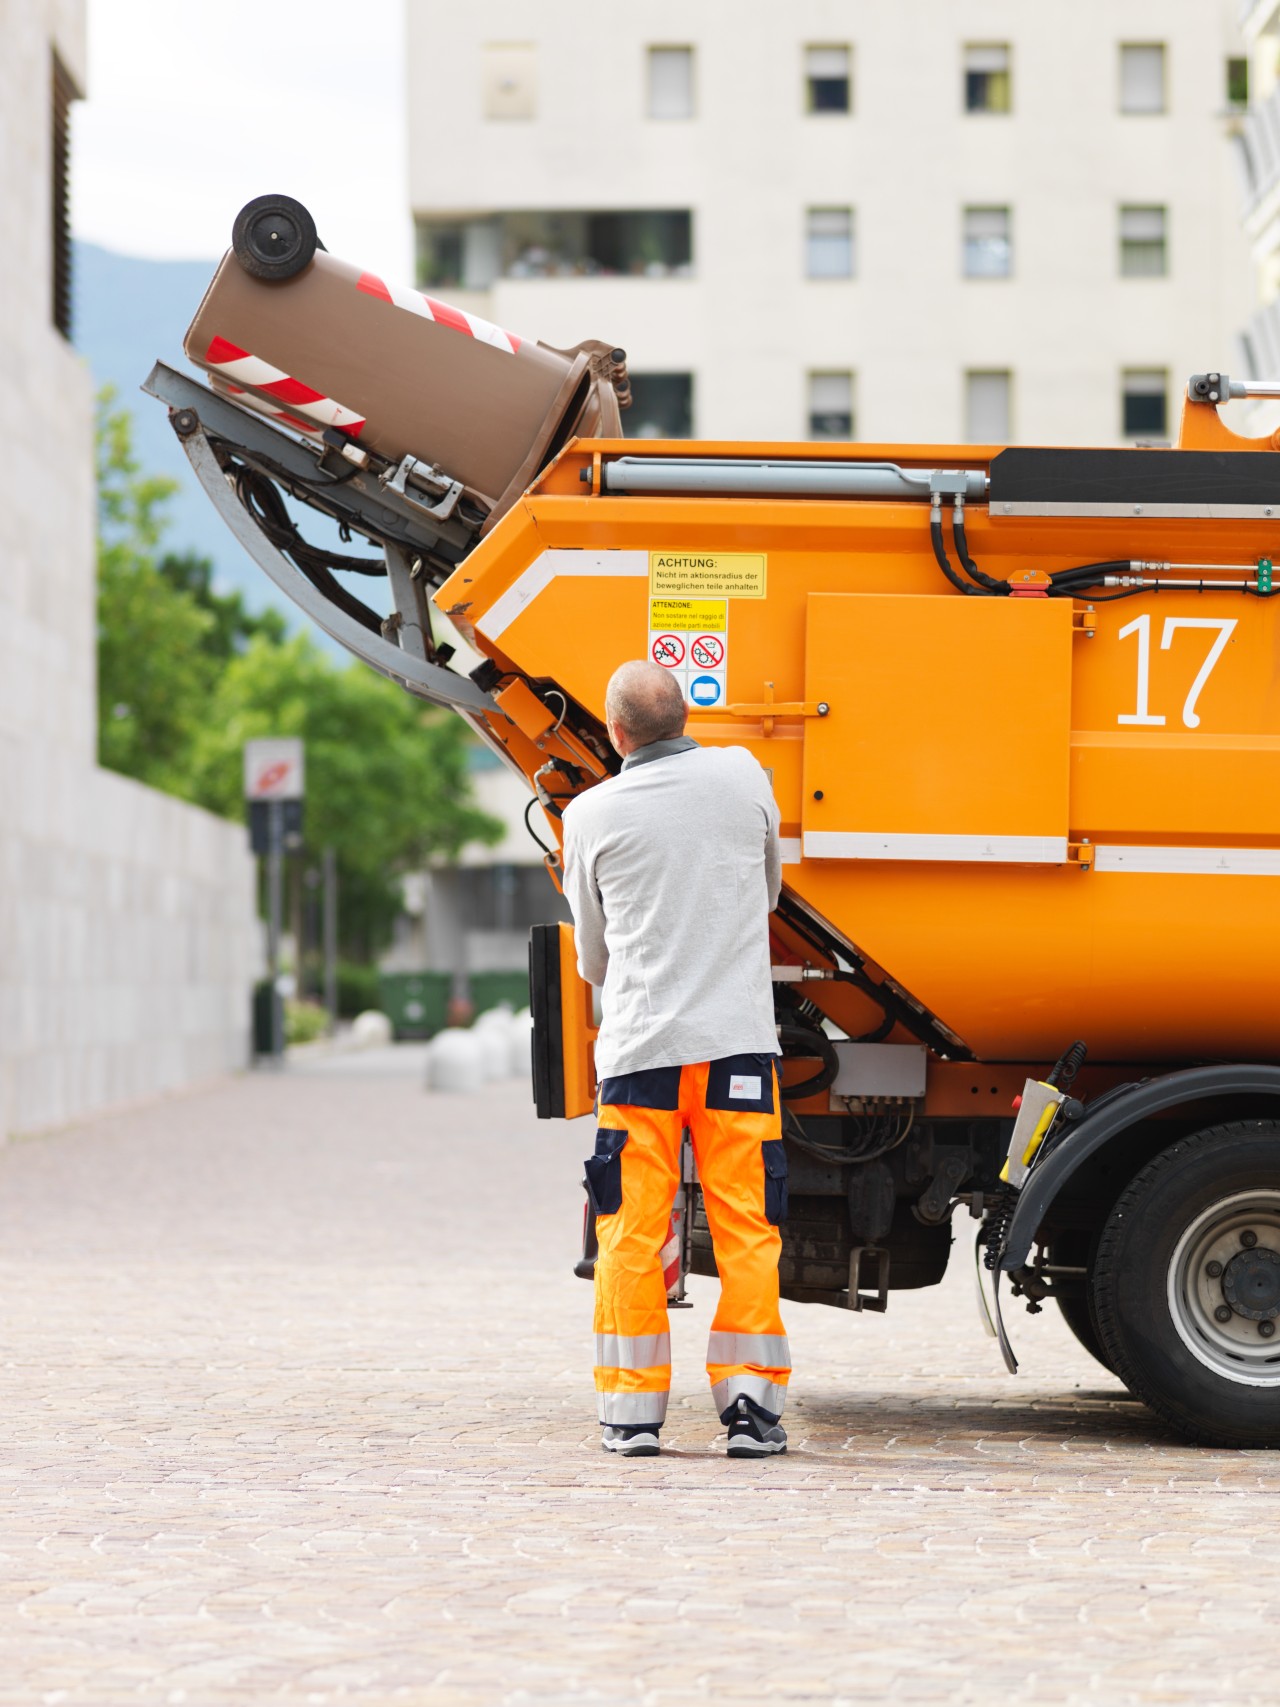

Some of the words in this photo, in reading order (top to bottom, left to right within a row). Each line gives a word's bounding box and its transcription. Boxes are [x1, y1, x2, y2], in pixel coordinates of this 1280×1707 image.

[657, 558, 717, 568] ACHTUNG:
[656, 571, 676, 579] Nicht
[690, 572, 743, 580] aktionsradius
[656, 582, 704, 591] beweglichen
[725, 583, 758, 591] anhalten
[652, 601, 692, 609] ATTENZIONE:
[1118, 614, 1238, 728] 17
